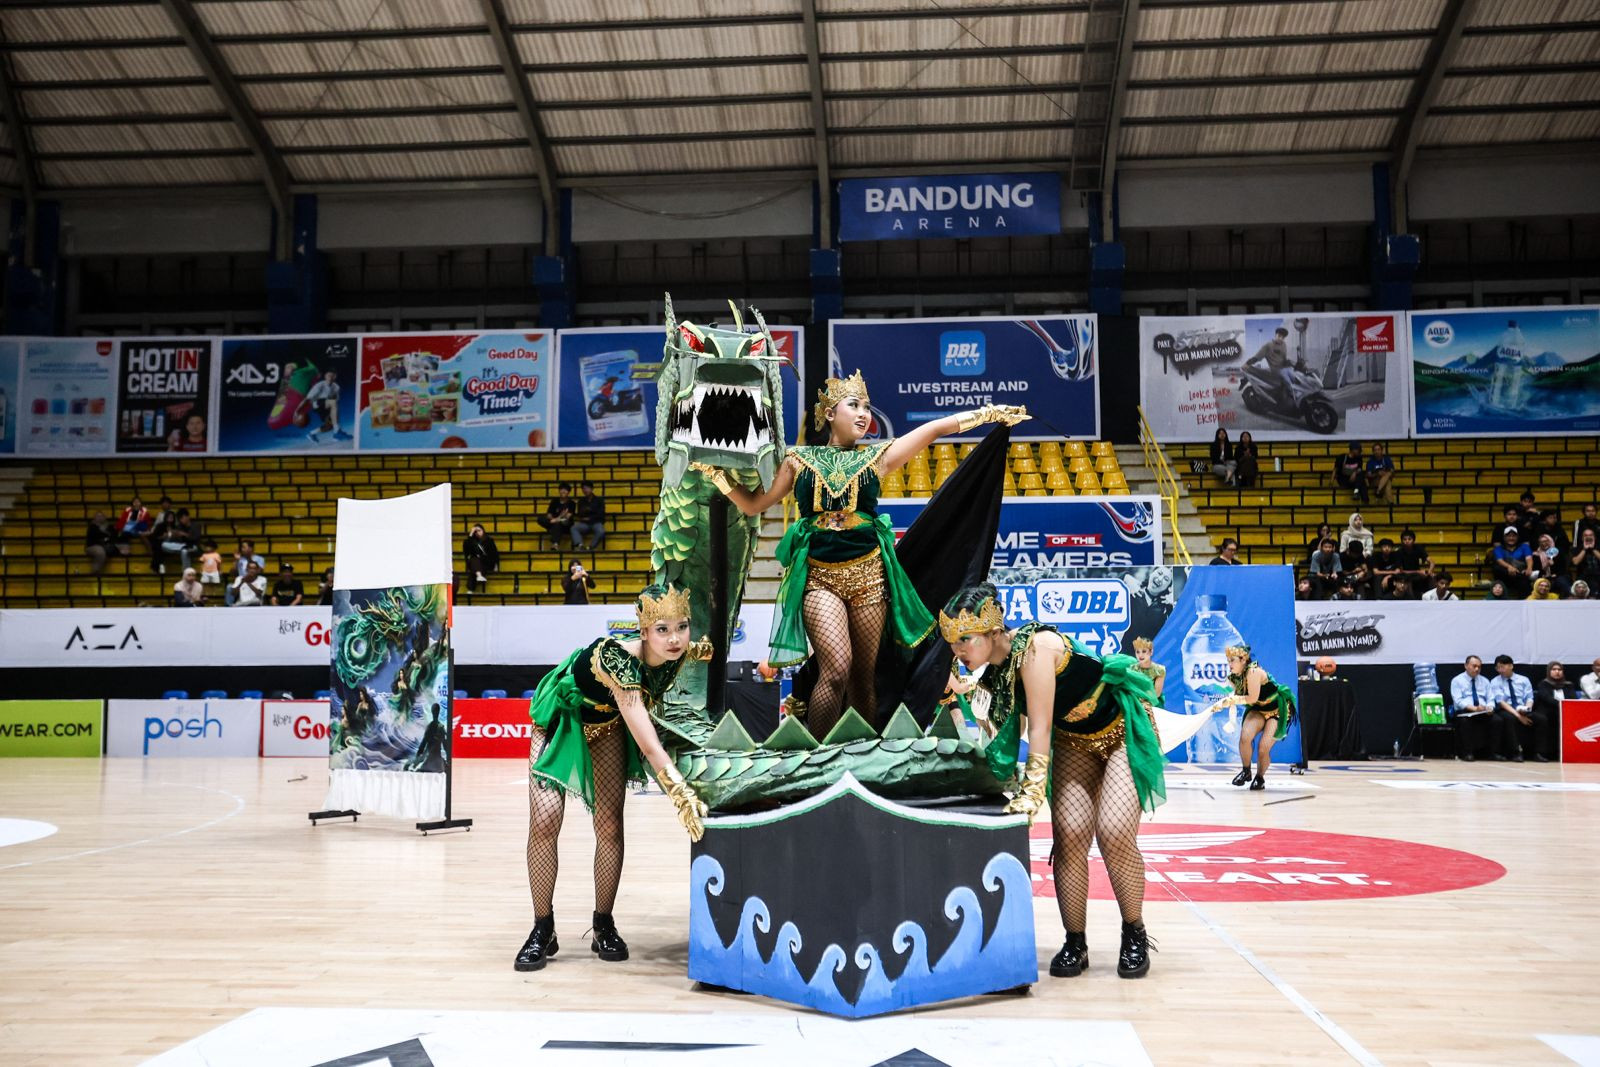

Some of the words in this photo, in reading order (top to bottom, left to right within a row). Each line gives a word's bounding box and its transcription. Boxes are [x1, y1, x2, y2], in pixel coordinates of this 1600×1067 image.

[865, 183, 1034, 213] BANDUNG
[893, 215, 1007, 231] ARENA
[488, 349, 515, 360] Good
[517, 348, 538, 361] Day
[945, 343, 980, 358] DBL
[128, 348, 175, 372] HOT
[945, 358, 979, 366] PLAY
[127, 373, 198, 393] CREAM
[468, 377, 506, 395] Good
[509, 375, 537, 392] Day
[898, 382, 994, 394] LIVESTREAM
[997, 380, 1029, 392] AND
[481, 391, 524, 409] Time!
[934, 395, 992, 407] UPDATE
[994, 531, 1040, 549] ME
[991, 552, 1133, 567] EAMERS
[1068, 591, 1123, 613] DBL
[1302, 639, 1320, 653] GAYA
[1321, 637, 1345, 651] MAKIN
[1190, 662, 1228, 682] AQU
[143, 703, 222, 755] posh
[460, 723, 532, 738] HON
